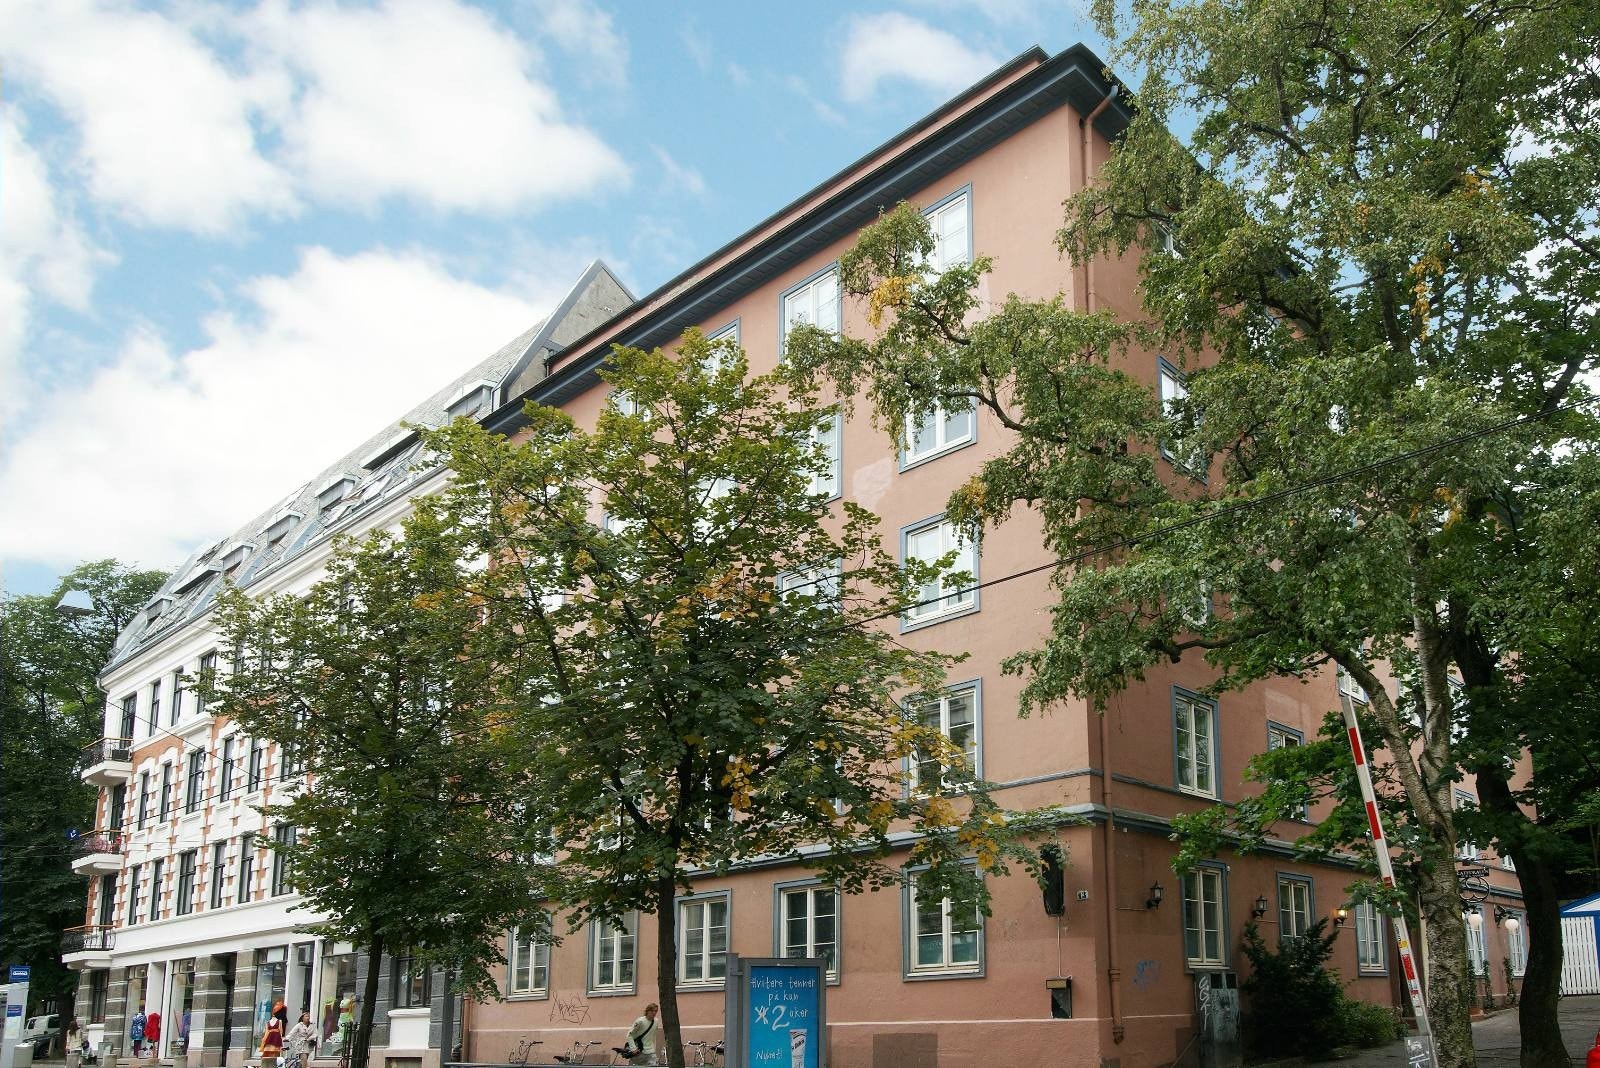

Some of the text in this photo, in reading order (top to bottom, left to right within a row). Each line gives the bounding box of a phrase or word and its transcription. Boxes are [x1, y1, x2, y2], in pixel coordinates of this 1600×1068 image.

[750, 975, 816, 990] Hvitere tenner
[771, 1005, 790, 1031] 2
[789, 1008, 809, 1018] uker
